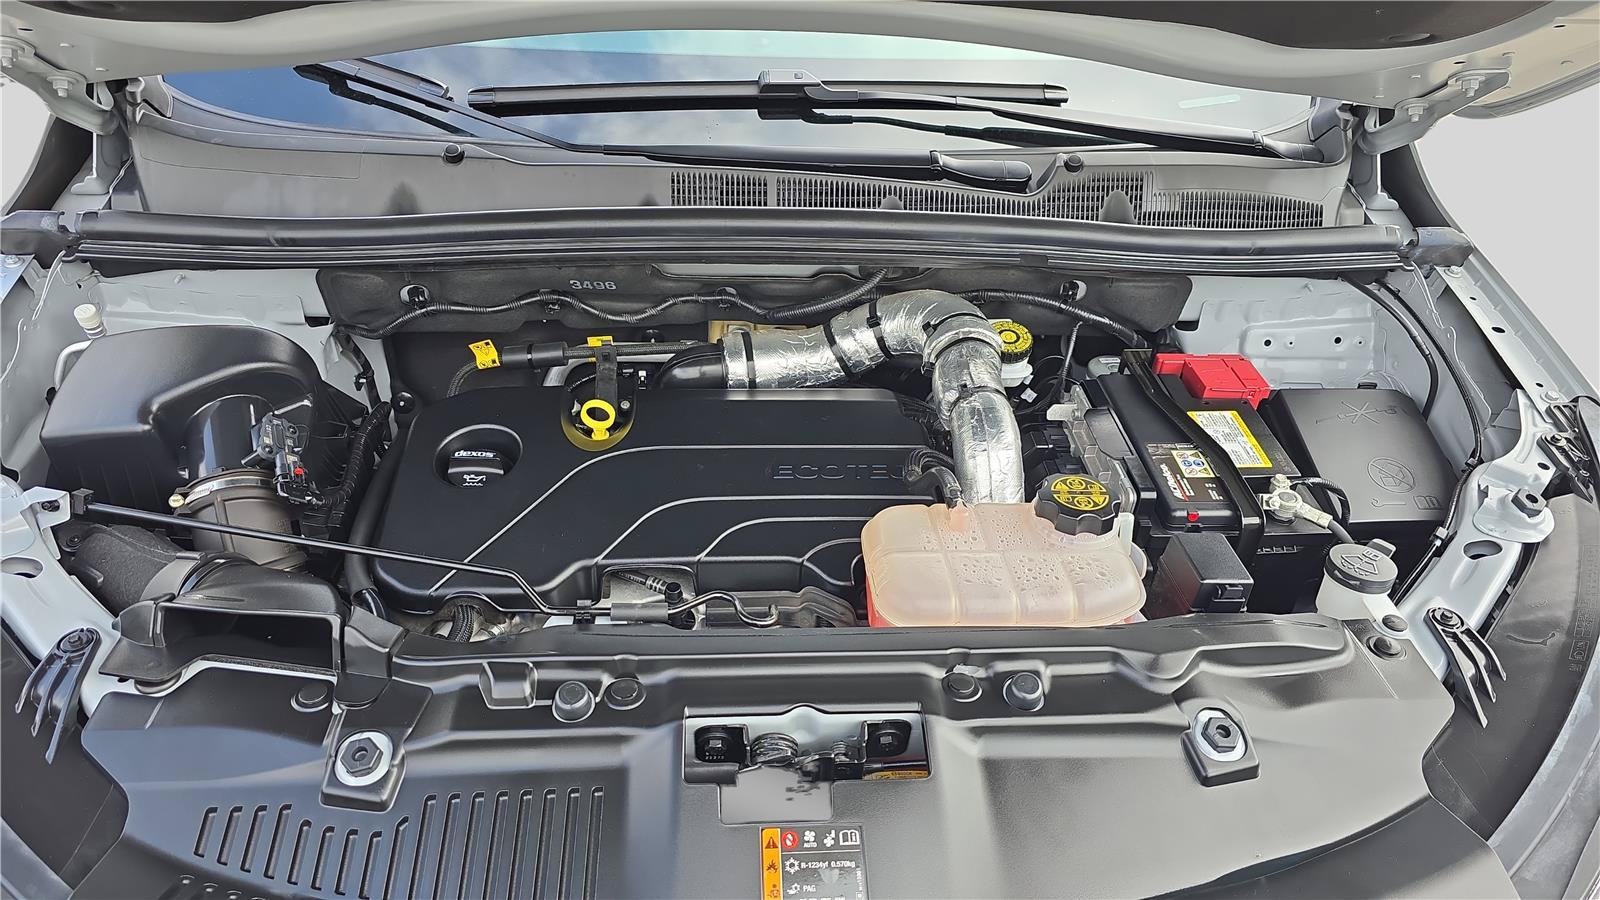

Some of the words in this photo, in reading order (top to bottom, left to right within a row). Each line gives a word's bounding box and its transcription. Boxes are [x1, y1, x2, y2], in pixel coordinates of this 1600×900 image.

[569, 279, 617, 290] 3496
[454, 449, 496, 458] dexos
[800, 861, 829, 869] R-1234yf
[830, 860, 856, 868] 0.570kg
[802, 884, 817, 892] PAG
